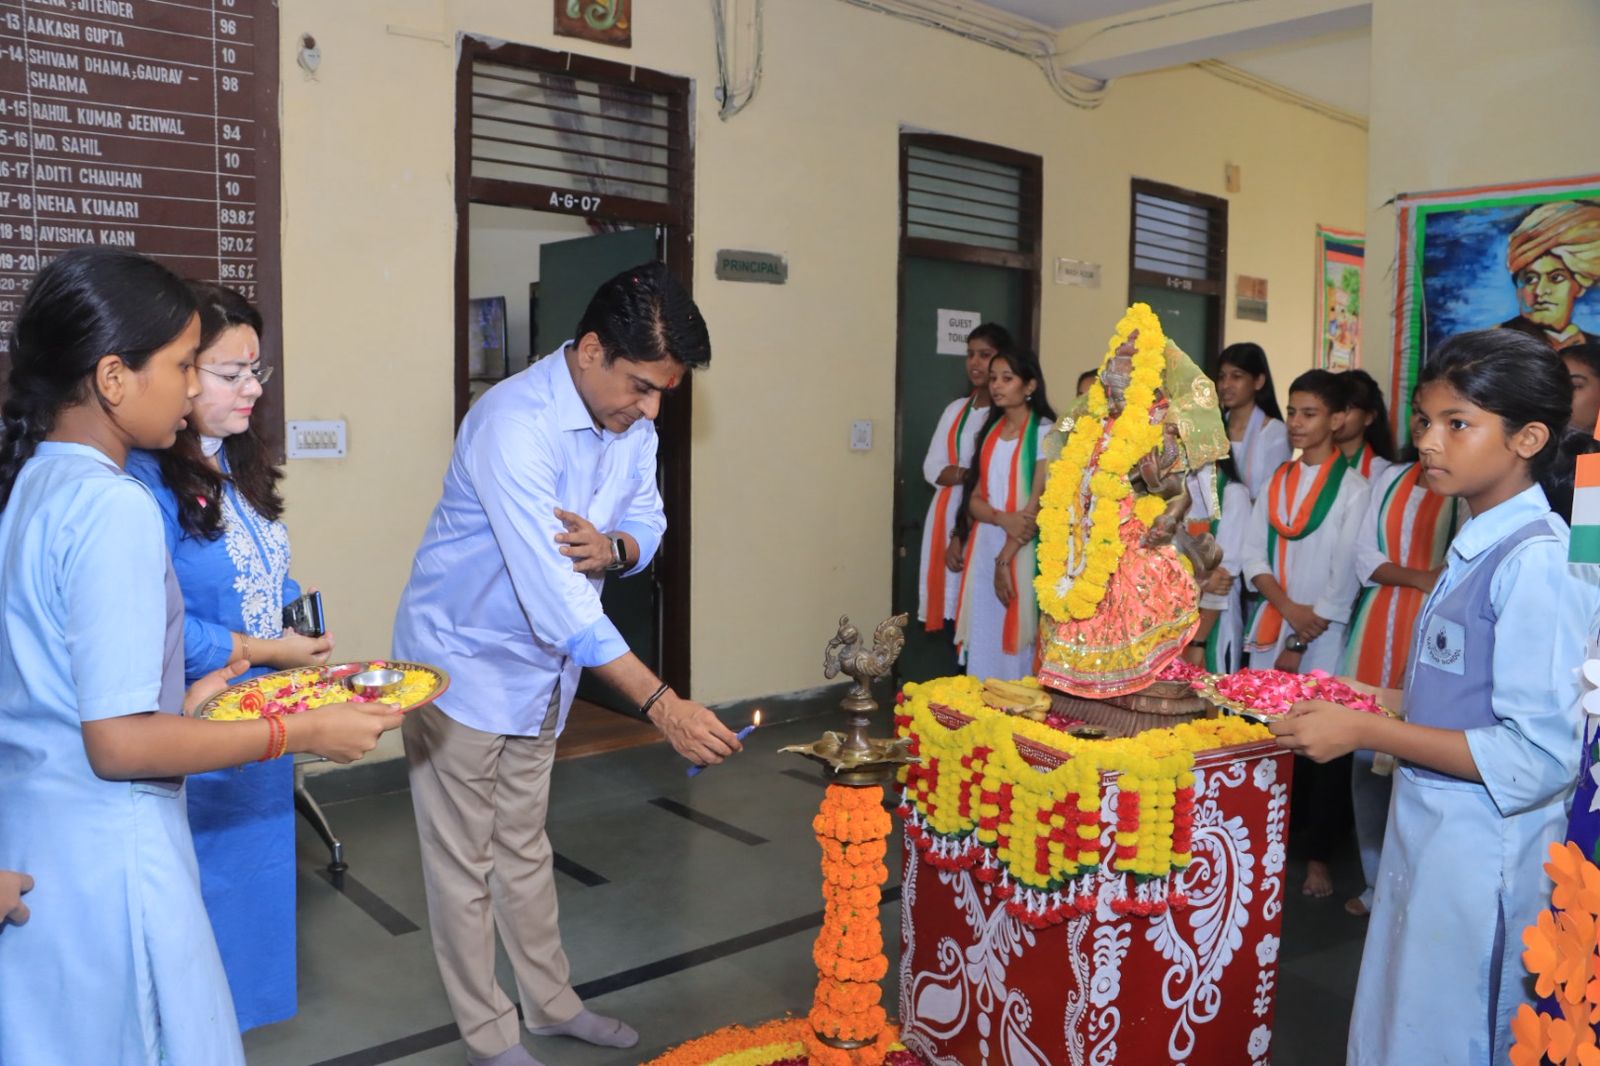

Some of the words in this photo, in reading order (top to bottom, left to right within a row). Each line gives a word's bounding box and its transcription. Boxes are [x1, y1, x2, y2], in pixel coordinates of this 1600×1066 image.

[27, 16, 80, 40] AAKASH
[85, 26, 125, 47] GUPTA
[29, 48, 79, 70] SHIVAM
[222, 47, 236, 64] 10
[30, 71, 88, 95] SHARMA
[32, 102, 72, 124] RAHUL
[77, 107, 122, 129] KUMAR
[128, 113, 185, 136] JEENWAL
[34, 132, 58, 151] MD.
[62, 136, 102, 157] SAHIL
[224, 152, 240, 169] 10
[36, 163, 73, 184] ADITI
[79, 168, 142, 190] CHAUHAN
[225, 181, 240, 196] 10
[37, 194, 76, 213] NEHA
[82, 198, 139, 219] KUMARI
[549, 191, 600, 212] A-G-07
[39, 225, 95, 245] AVISHKA
[100, 230, 136, 247] KARN
[722, 259, 781, 275] PRINCIPAL
[949, 318, 971, 329] GUEST
[948, 332, 969, 343] TOILE
